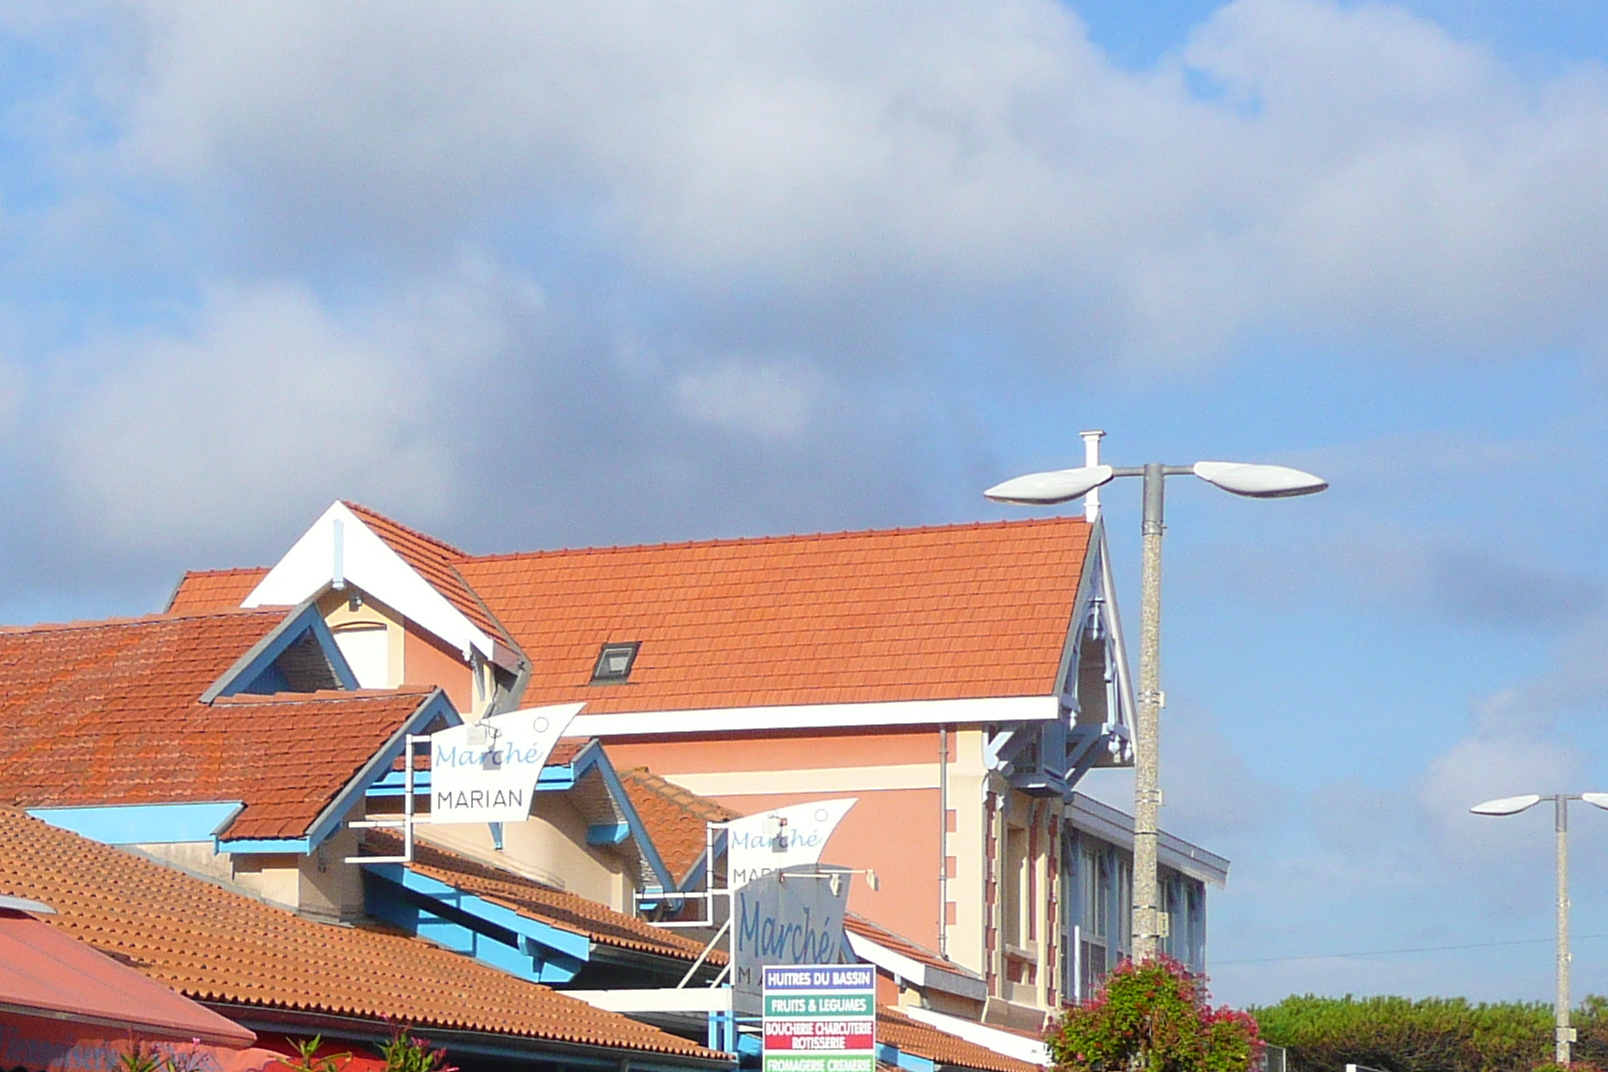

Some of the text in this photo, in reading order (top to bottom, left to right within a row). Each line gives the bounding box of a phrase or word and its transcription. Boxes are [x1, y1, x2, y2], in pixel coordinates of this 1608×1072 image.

[435, 741, 543, 768] Marché
[437, 788, 523, 810] MARIAN
[731, 828, 823, 850] Marché
[738, 893, 836, 965] Marché
[768, 972, 811, 986] HUITRES
[813, 972, 830, 986] DU
[832, 971, 871, 985] BASSIN
[771, 998, 867, 1013] FRUITS & LEGUMES
[765, 1022, 873, 1036] BOUCHERIE CHARCUTERIE
[792, 1036, 846, 1050] ROTISSERIE
[767, 1059, 872, 1072] FROMAGERIE CREMERIE
